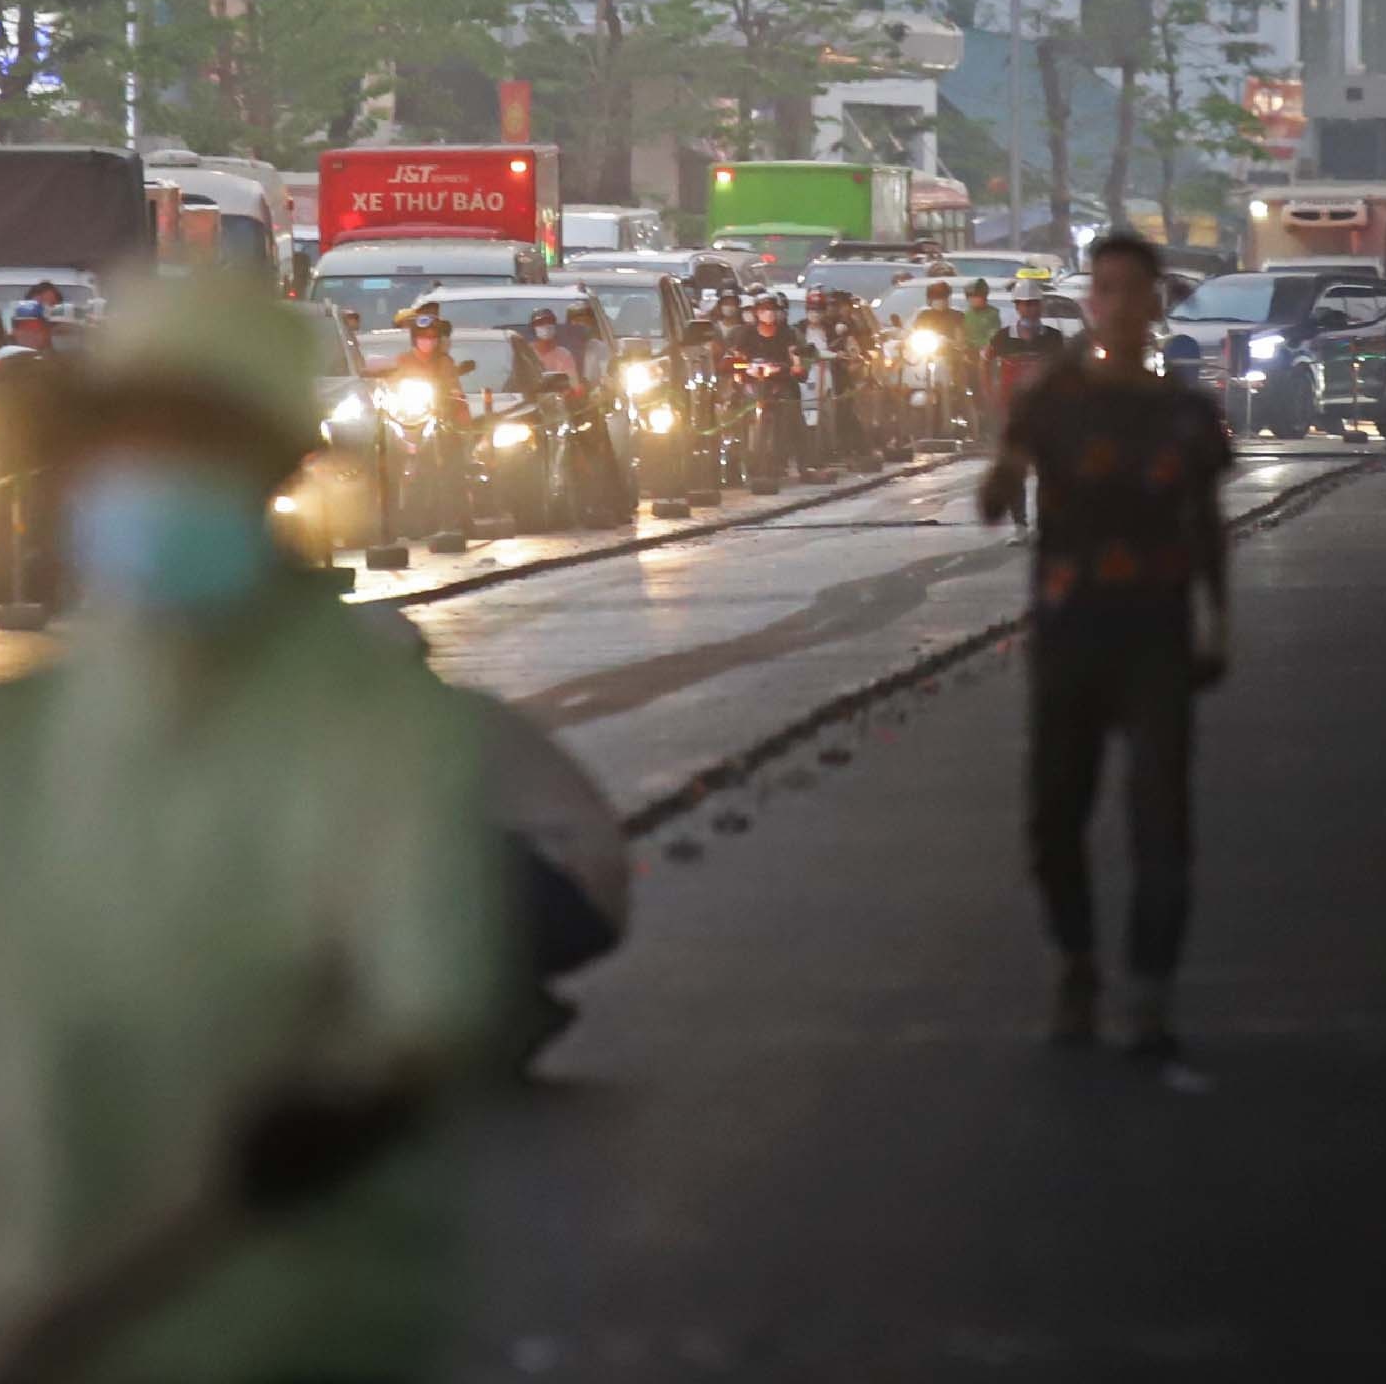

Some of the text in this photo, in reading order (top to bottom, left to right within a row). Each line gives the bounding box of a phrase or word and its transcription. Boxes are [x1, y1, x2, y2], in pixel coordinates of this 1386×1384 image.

[387, 165, 438, 183] J&T
[352, 193, 383, 211] XE
[391, 192, 447, 211] THƯ
